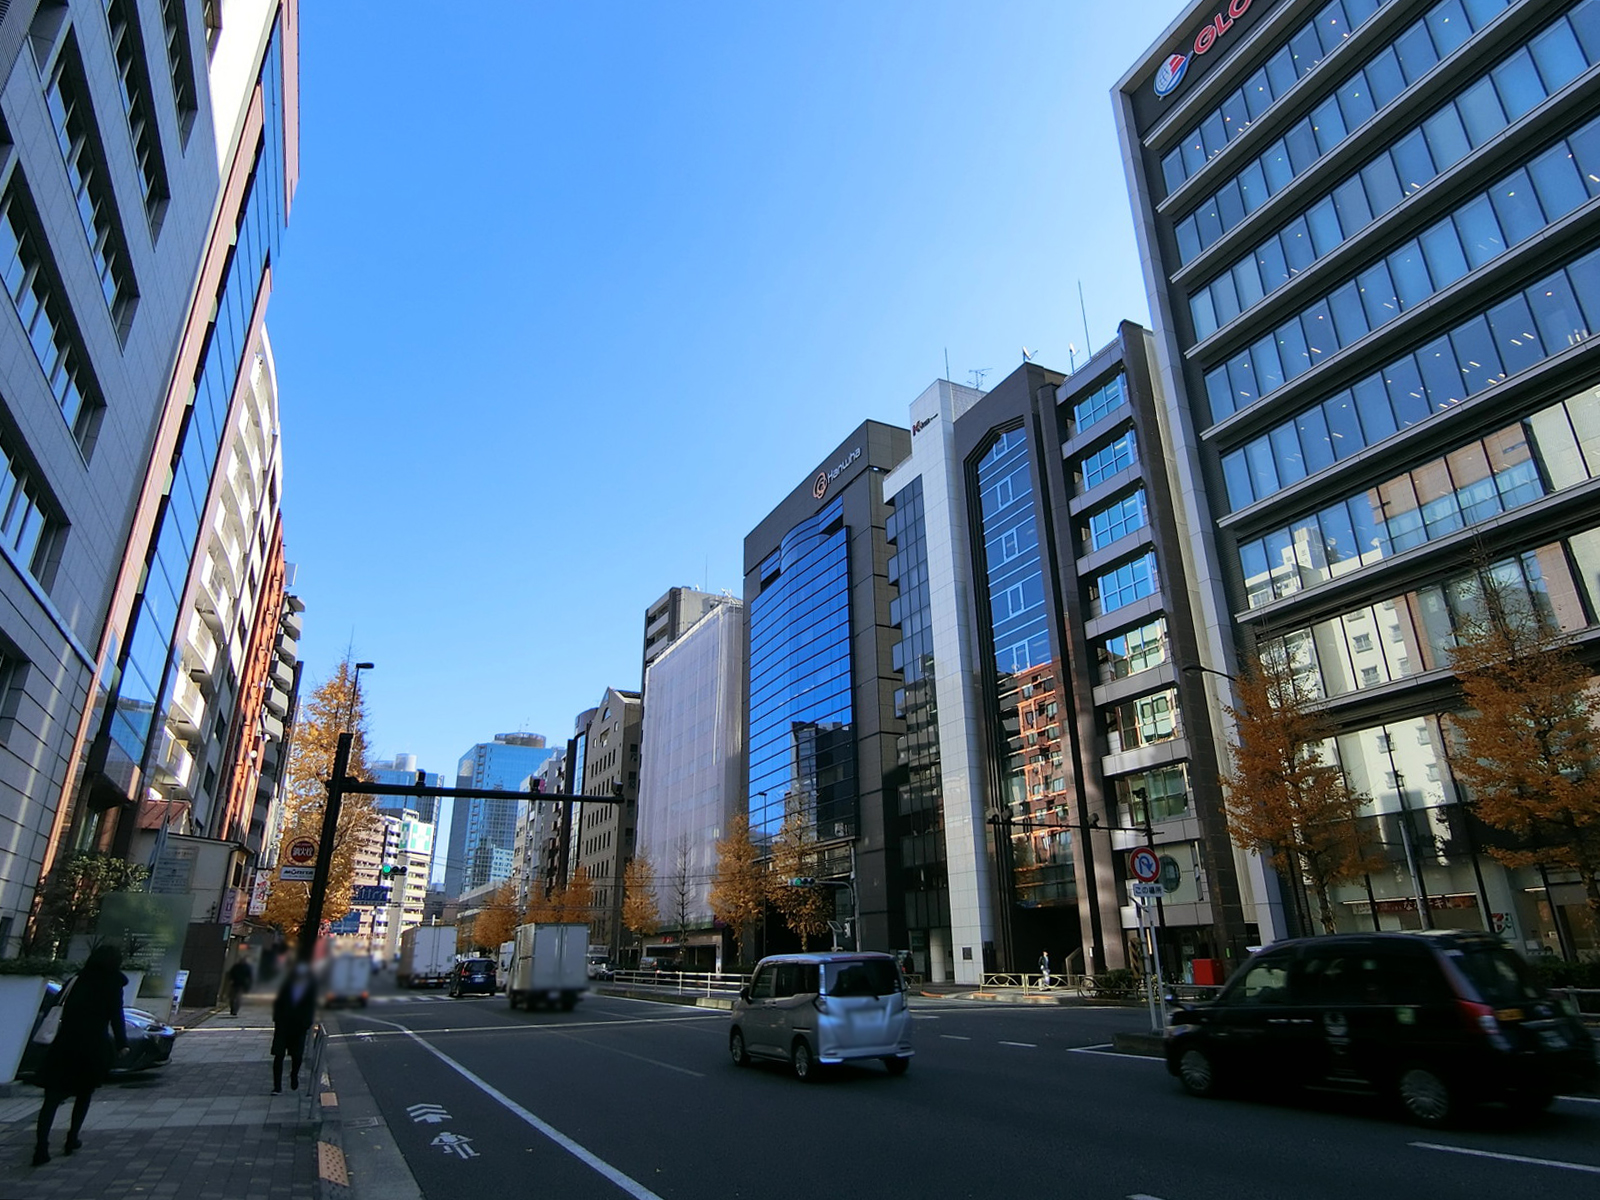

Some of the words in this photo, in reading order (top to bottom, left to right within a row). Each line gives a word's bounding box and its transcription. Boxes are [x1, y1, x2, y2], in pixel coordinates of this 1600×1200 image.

[827, 446, 862, 484] Hanwha
[1135, 886, 1162, 895] この場所
